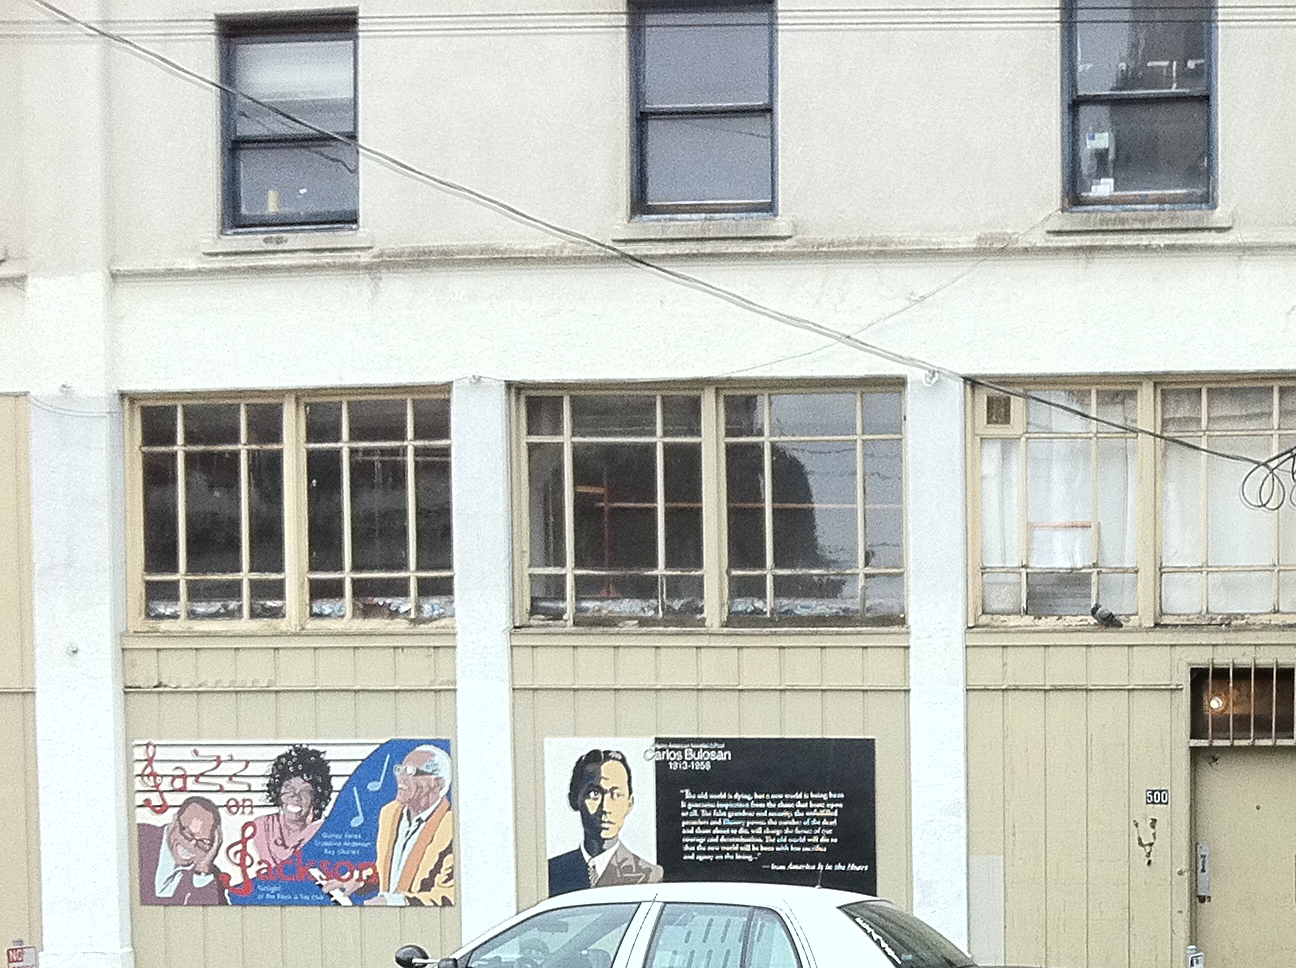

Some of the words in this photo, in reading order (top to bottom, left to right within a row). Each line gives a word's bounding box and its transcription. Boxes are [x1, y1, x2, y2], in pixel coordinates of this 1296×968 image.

[643, 749, 683, 761] Carlos
[685, 749, 731, 760] Bulosan
[141, 741, 252, 814] Jazz
[226, 797, 254, 816] on
[1146, 790, 1168, 804] 500
[219, 821, 379, 896] Jackson
